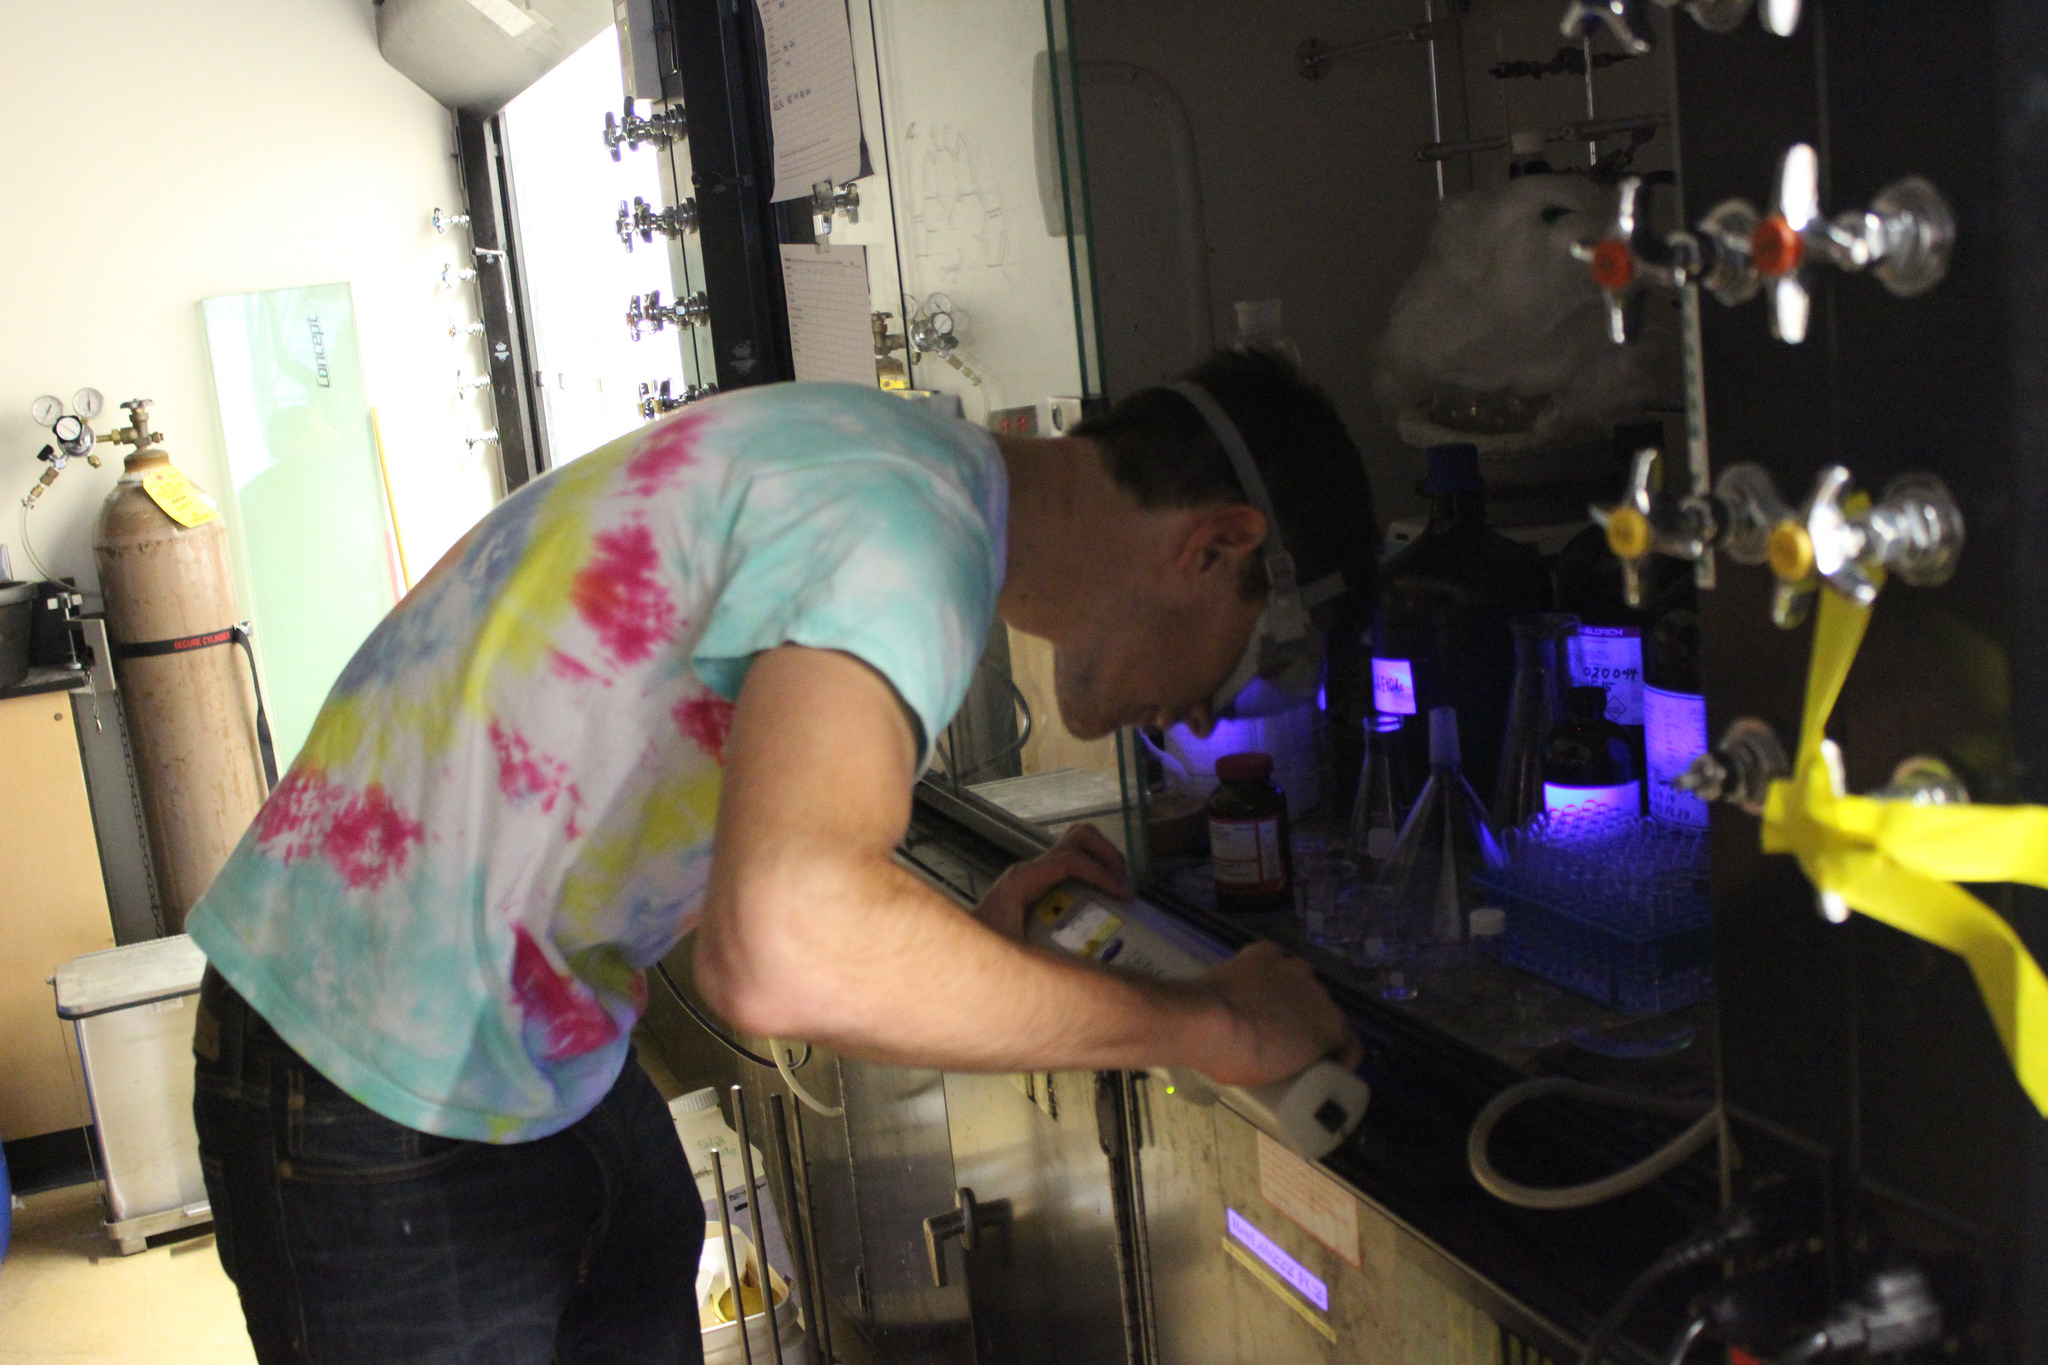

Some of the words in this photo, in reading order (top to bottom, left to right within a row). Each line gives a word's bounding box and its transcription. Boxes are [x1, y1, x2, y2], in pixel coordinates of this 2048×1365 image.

[307, 312, 330, 388] Concept
[173, 638, 202, 650] SECURE
[202, 631, 231, 646] CYLINDER
[1578, 627, 1624, 637] -ALDRICH
